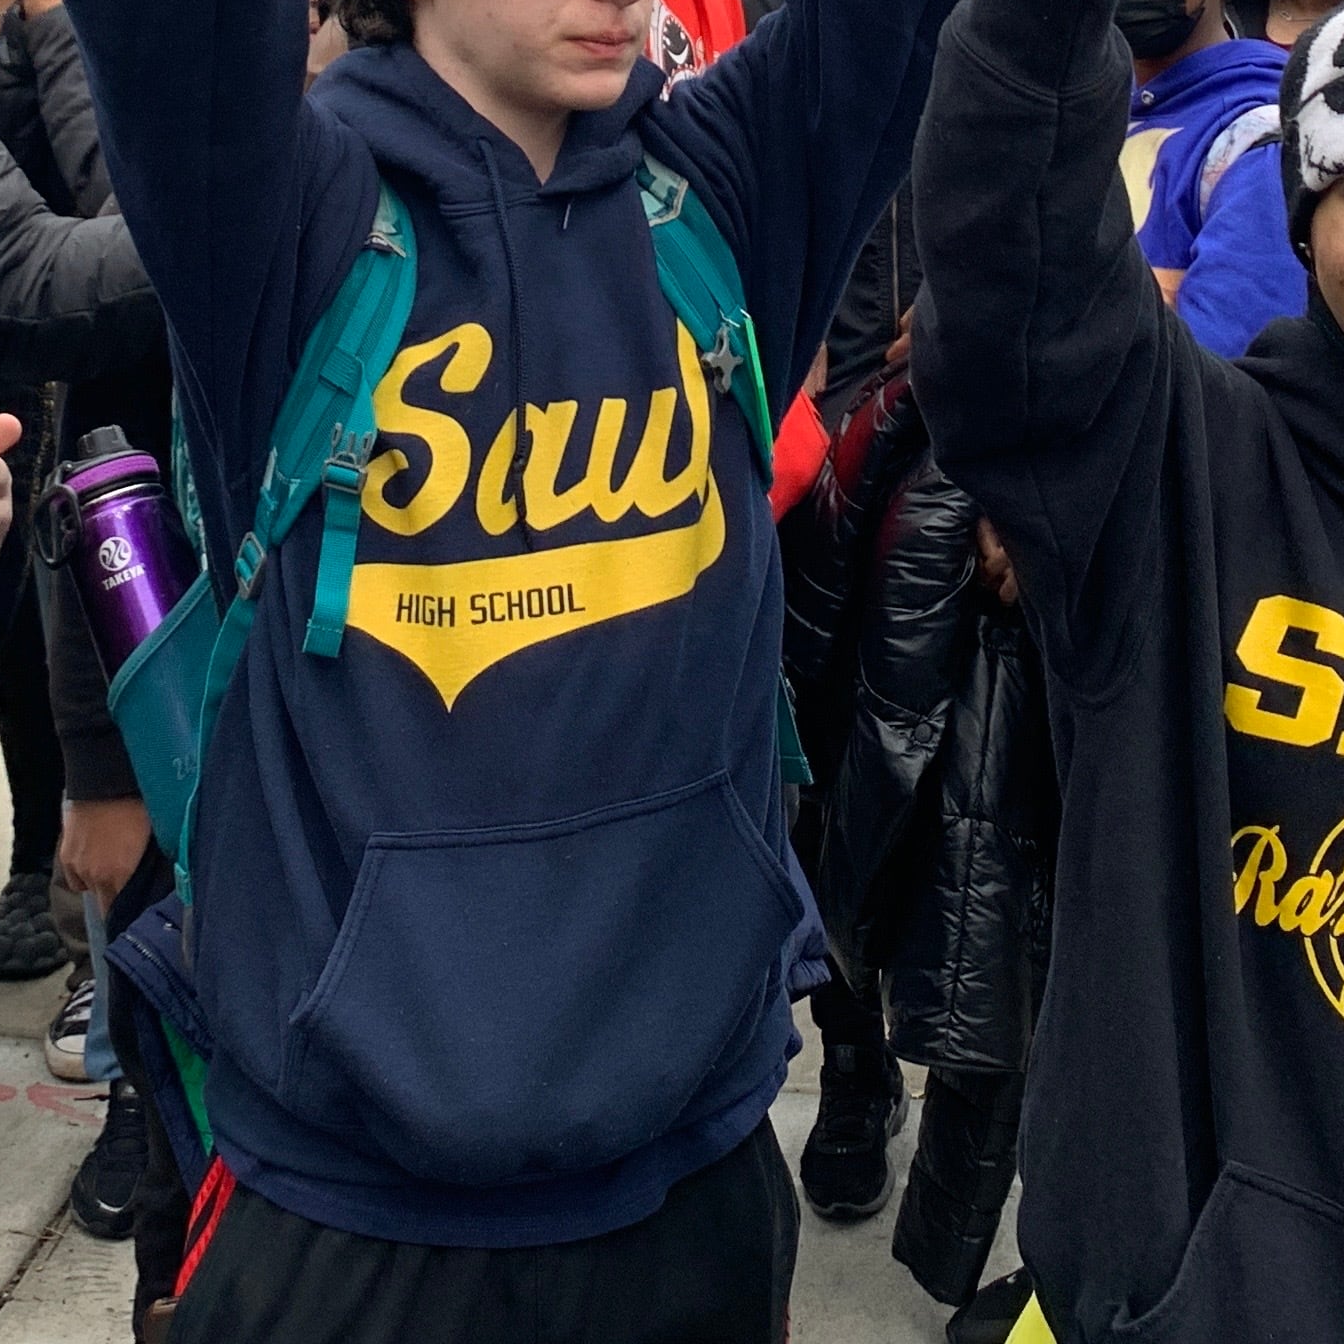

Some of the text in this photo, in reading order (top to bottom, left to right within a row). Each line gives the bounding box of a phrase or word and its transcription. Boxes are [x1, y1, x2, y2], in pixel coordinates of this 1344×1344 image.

[360, 317, 712, 537] Saul
[102, 563, 145, 591] TAKEYA
[396, 583, 586, 628] HIGH SCHOOL
